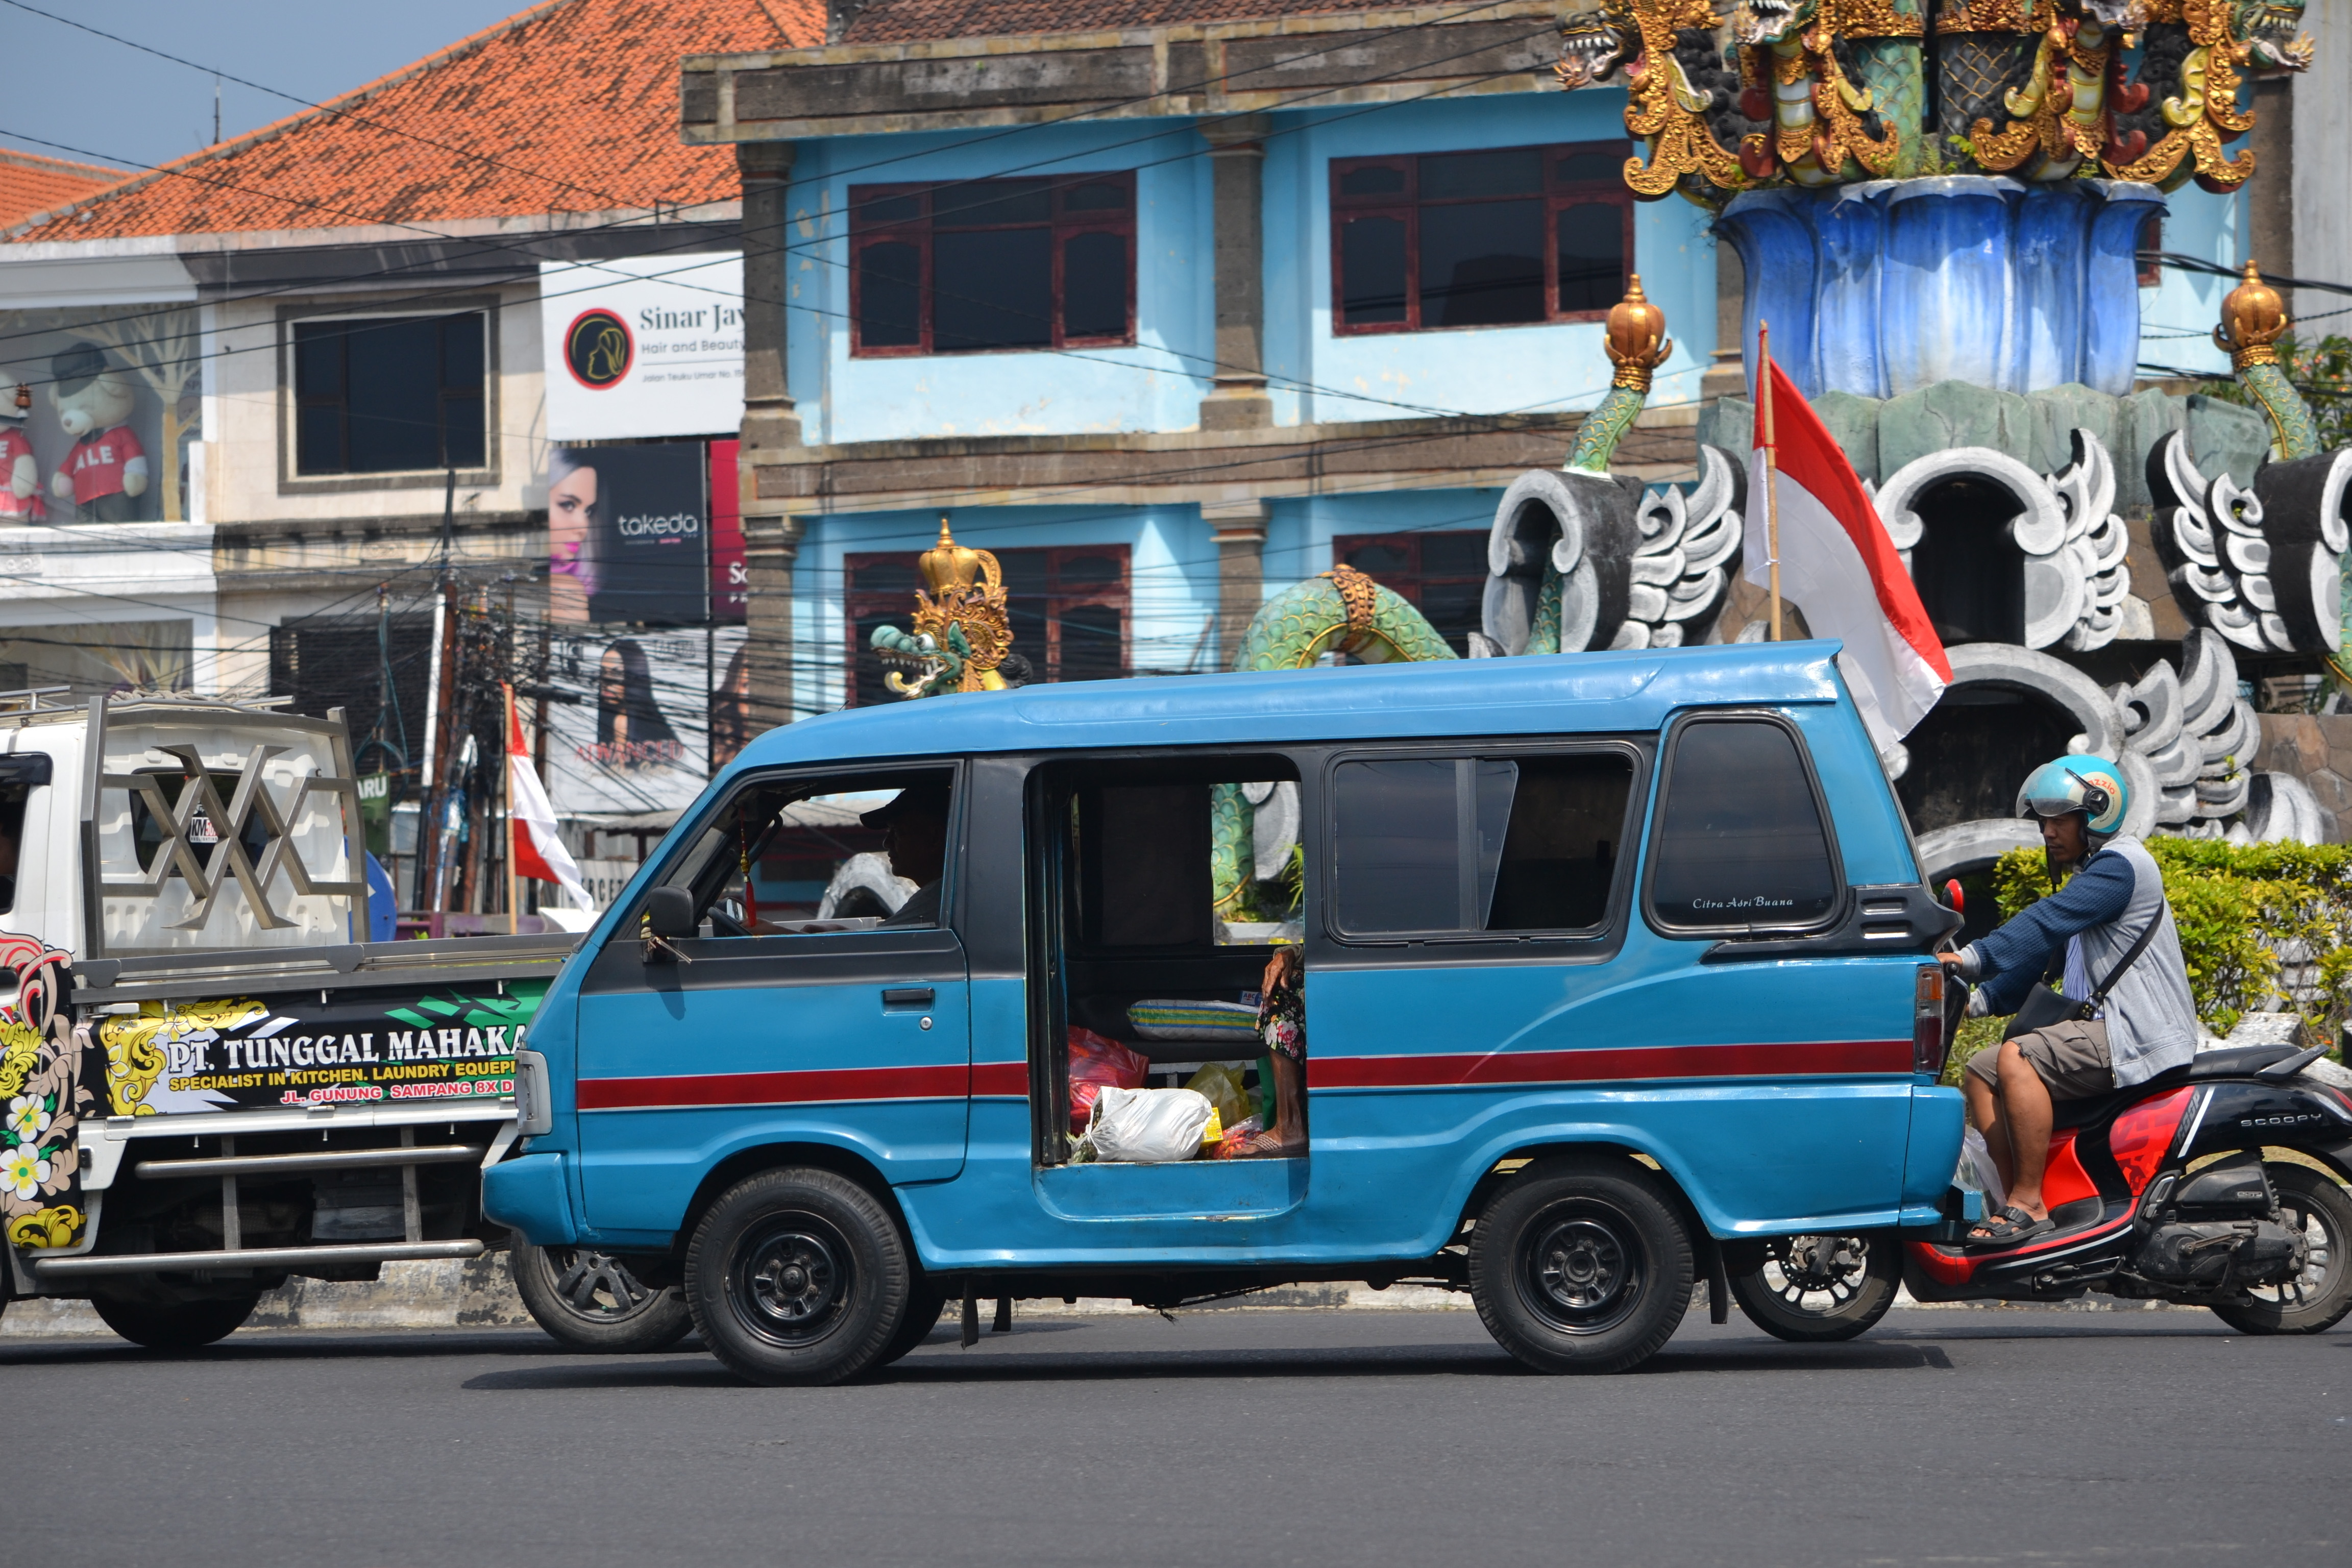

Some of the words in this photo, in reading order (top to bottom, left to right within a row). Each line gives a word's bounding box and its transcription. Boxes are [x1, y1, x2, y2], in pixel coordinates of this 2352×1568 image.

[640, 305, 707, 331] Sinar
[642, 342, 668, 354] Hair
[672, 340, 697, 353] and
[643, 373, 665, 383] Jalan
[668, 373, 692, 381] Teuku
[694, 371, 717, 380] Umar
[719, 370, 732, 378] No.
[1693, 898, 1724, 909] Citra
[1753, 896, 1794, 906] Buana
[168, 1040, 215, 1073] PT.
[224, 1033, 380, 1069] TUNGGAL
[388, 1025, 527, 1061] MAHAKA
[169, 1073, 264, 1091] SPECIALIST
[269, 1072, 286, 1086] IN
[291, 1068, 368, 1085] KITCHEN.
[373, 1064, 450, 1081] LAUNDRY
[281, 1090, 306, 1104] JL.
[309, 1086, 383, 1102] GUNUNG
[390, 1082, 472, 1099] SAMPANG
[475, 1080, 498, 1094] 8X
[501, 1080, 515, 1093] D
[2240, 1113, 2322, 1127] SCOOPY
